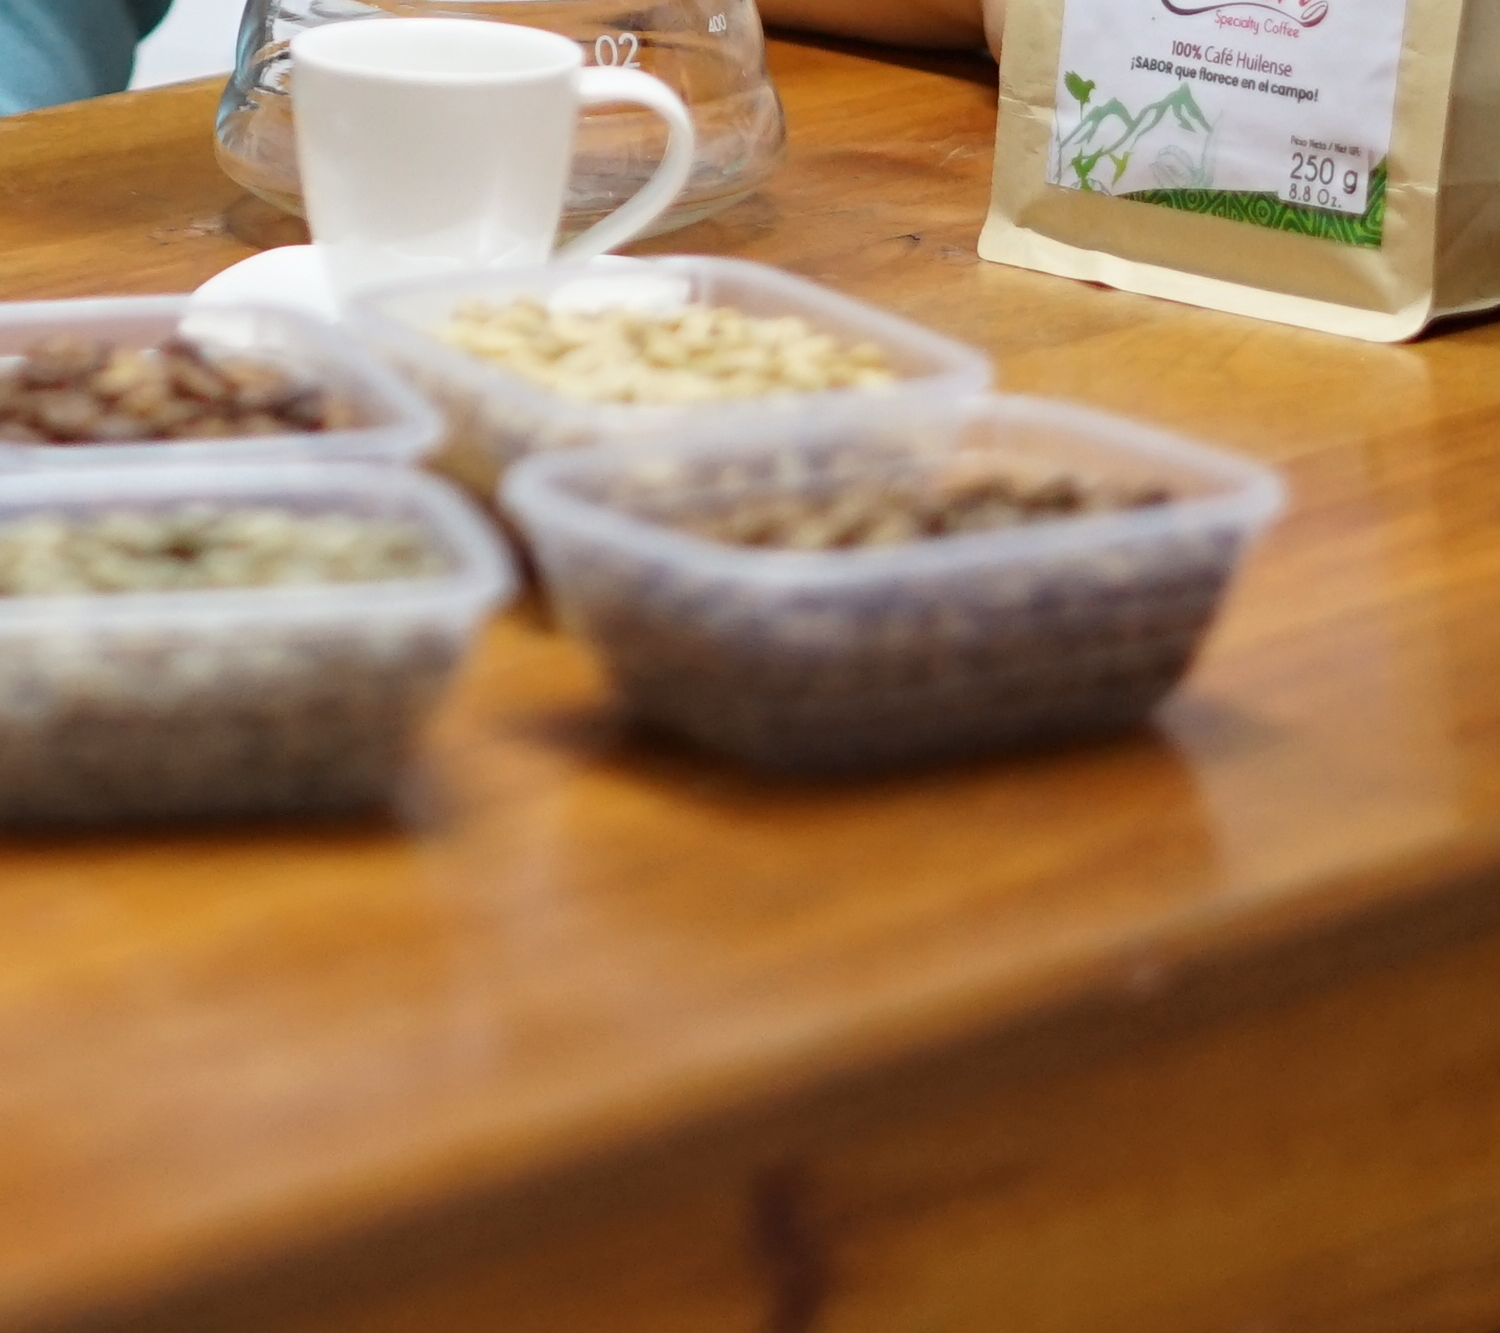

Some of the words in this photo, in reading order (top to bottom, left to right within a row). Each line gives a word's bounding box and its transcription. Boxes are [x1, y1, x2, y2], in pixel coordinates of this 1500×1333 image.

[707, 12, 728, 34] 400
[1213, 9, 1260, 35] Specialty
[1263, 17, 1301, 38] Coffee
[593, 32, 642, 69] 02
[1171, 39, 1203, 61] 100%
[1204, 44, 1235, 66] Café
[1236, 50, 1294, 78] Huilense
[1130, 55, 1174, 75] ¡SABOR
[1175, 64, 1198, 83] que
[1198, 65, 1239, 88] florece
[1240, 77, 1256, 91] en
[1257, 79, 1270, 93] el
[1270, 83, 1320, 106] campo!
[1289, 151, 1336, 186] 250
[1341, 169, 1360, 195] g
[1288, 183, 1312, 202] 8.8
[1315, 187, 1343, 210] Oz.
